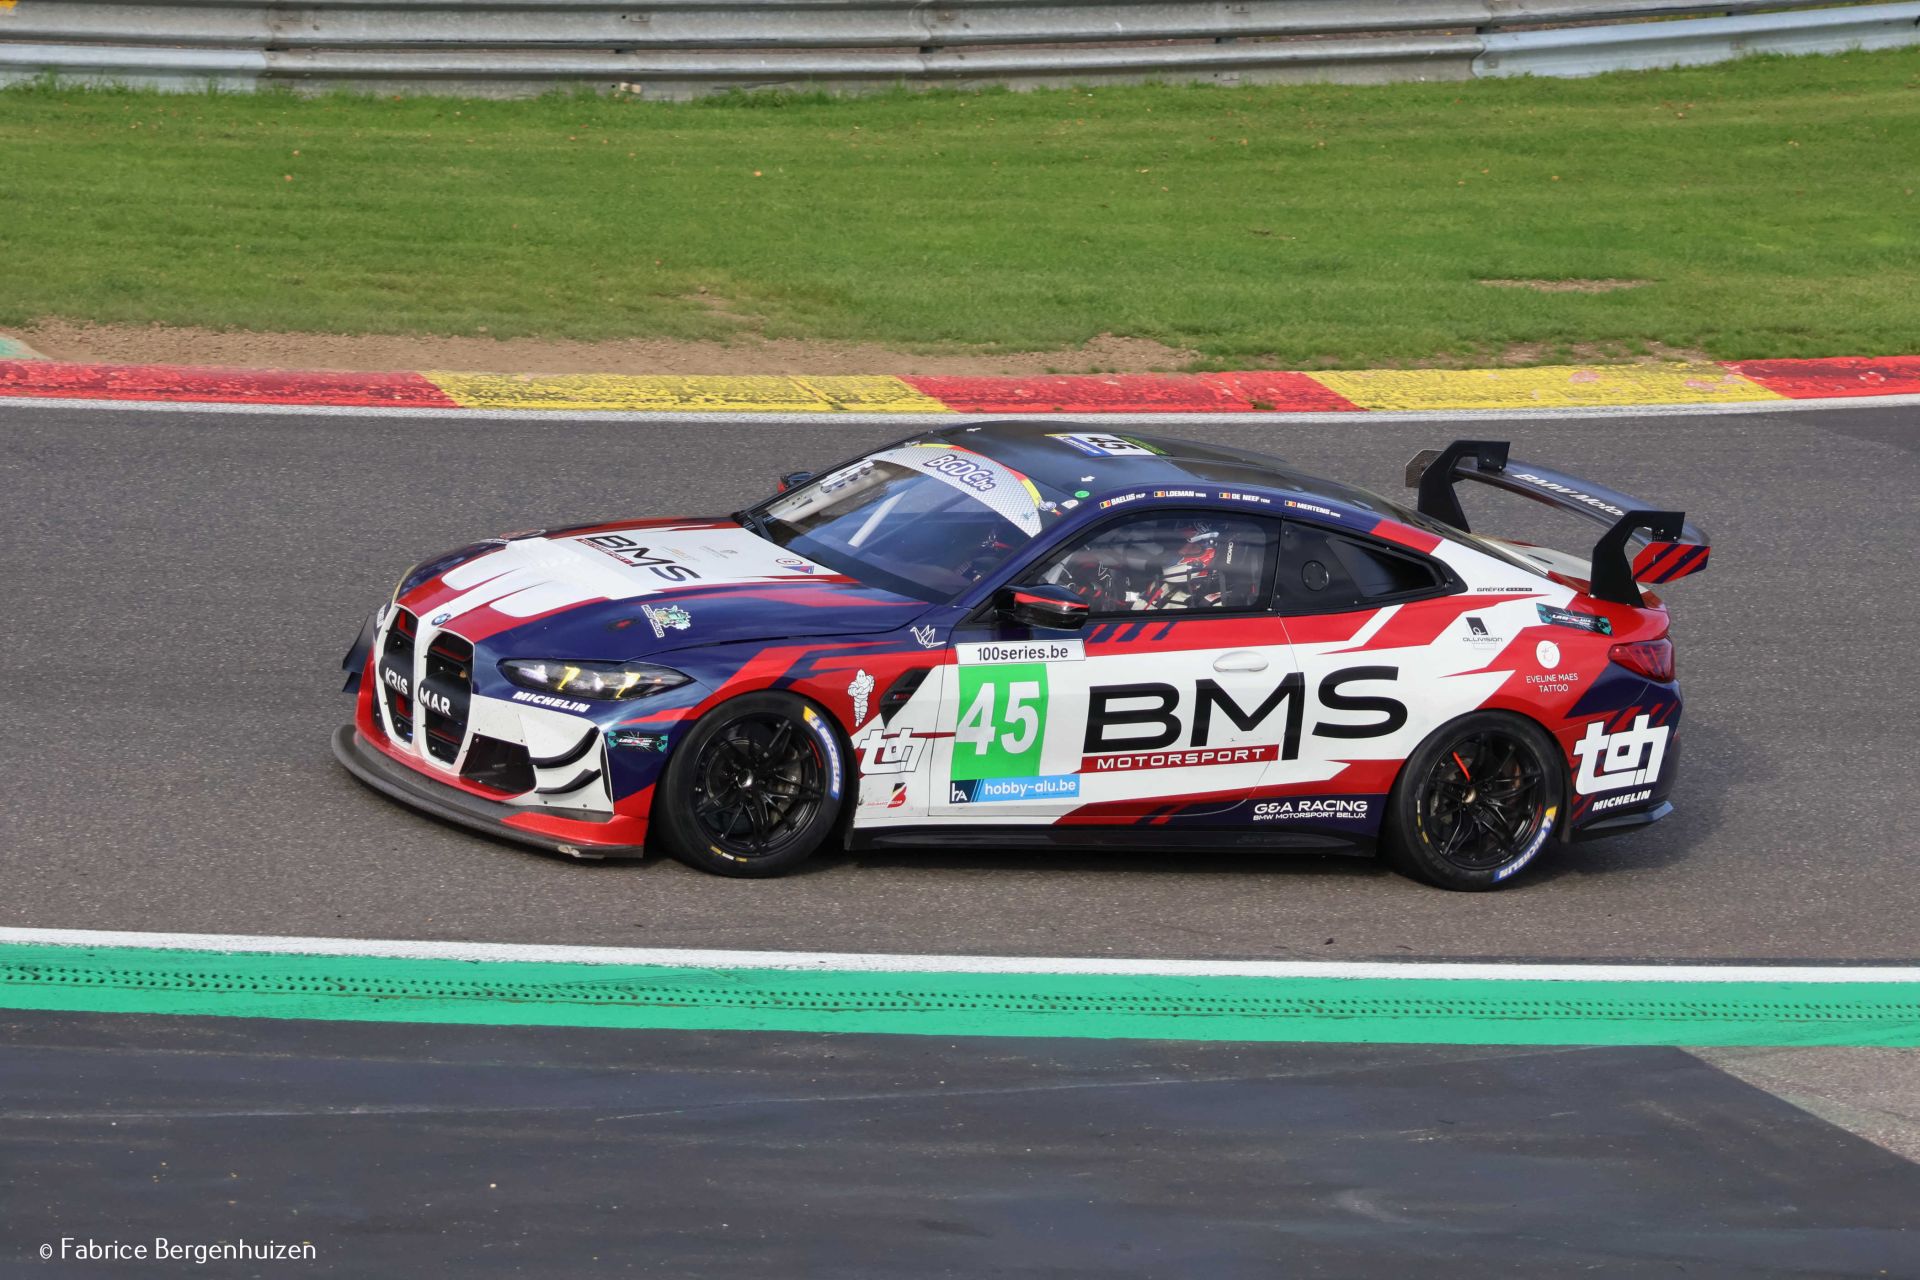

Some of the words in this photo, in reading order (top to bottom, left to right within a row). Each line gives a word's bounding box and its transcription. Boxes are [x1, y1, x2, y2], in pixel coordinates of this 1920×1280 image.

[1512, 473, 1579, 495] BMW
[585, 535, 702, 582] BMS
[977, 646, 1069, 661] 100series.be
[385, 667, 408, 695] KRIS
[1526, 674, 1557, 684] EVELINE
[1558, 672, 1579, 682] MAES
[1539, 683, 1569, 693] TATTOO
[419, 687, 452, 717] MAR
[512, 691, 591, 713] MICHELIN
[1083, 665, 1408, 761] BMS
[955, 681, 1040, 755] 45
[1096, 748, 1266, 770] MOTORSPORT
[984, 780, 1077, 797] hobby-alu.be
[1254, 802, 1293, 815] G&A
[1298, 800, 1368, 812] RACING
[1592, 789, 1652, 812] MICHELIN
[1275, 811, 1335, 819] MOTORSPORT
